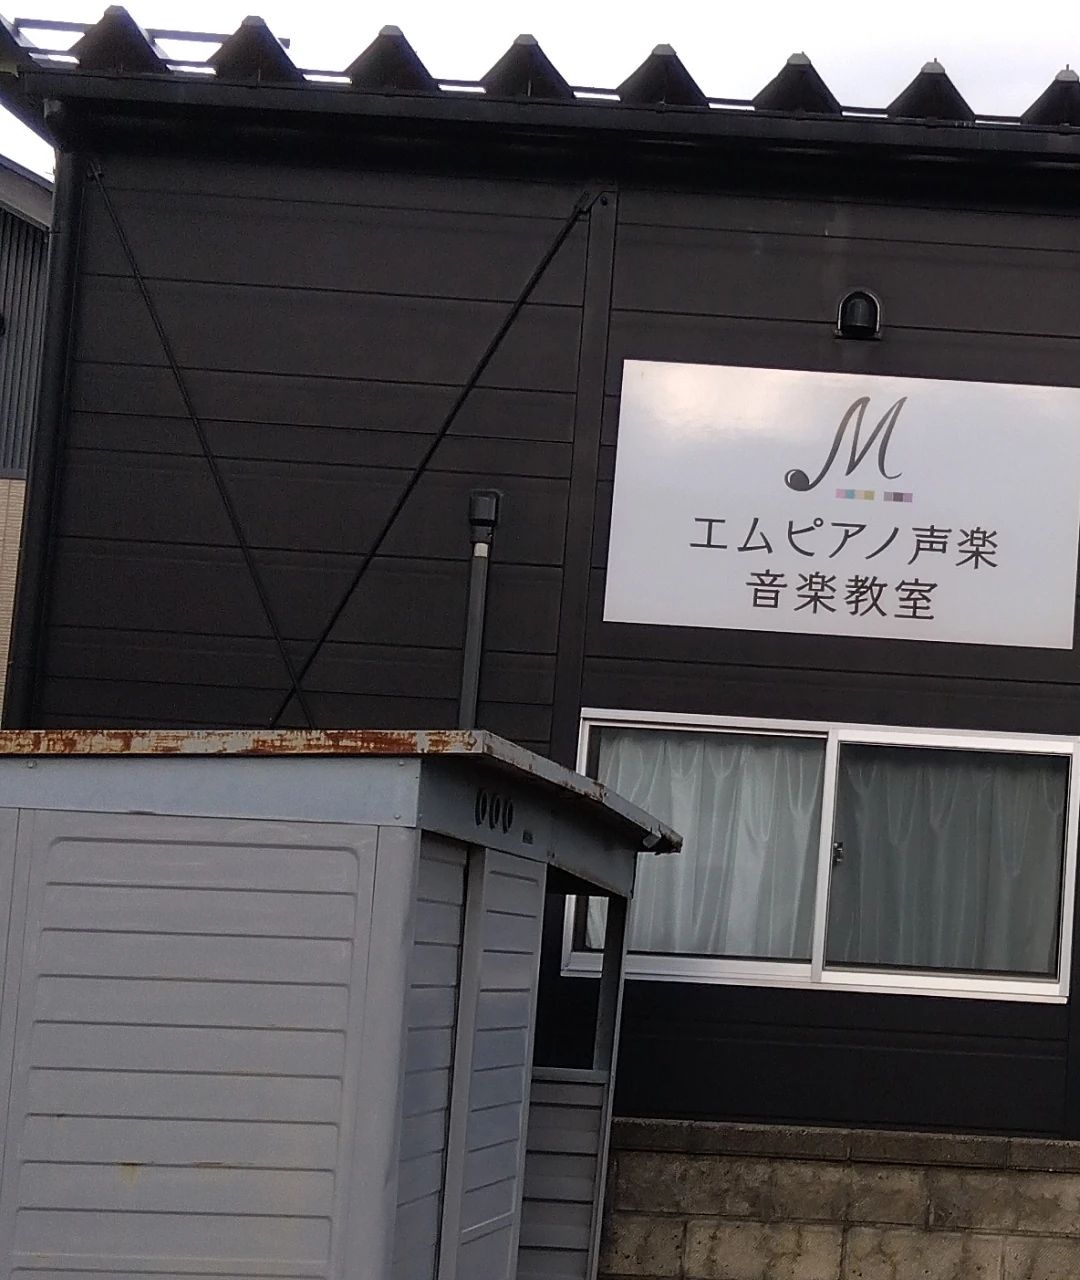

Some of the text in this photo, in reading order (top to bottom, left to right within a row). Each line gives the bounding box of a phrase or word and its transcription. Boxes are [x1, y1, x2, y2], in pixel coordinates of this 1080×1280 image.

[784, 396, 908, 492] M
[689, 517, 999, 570] エムピアノ声楽
[745, 568, 938, 620] 音楽教室
